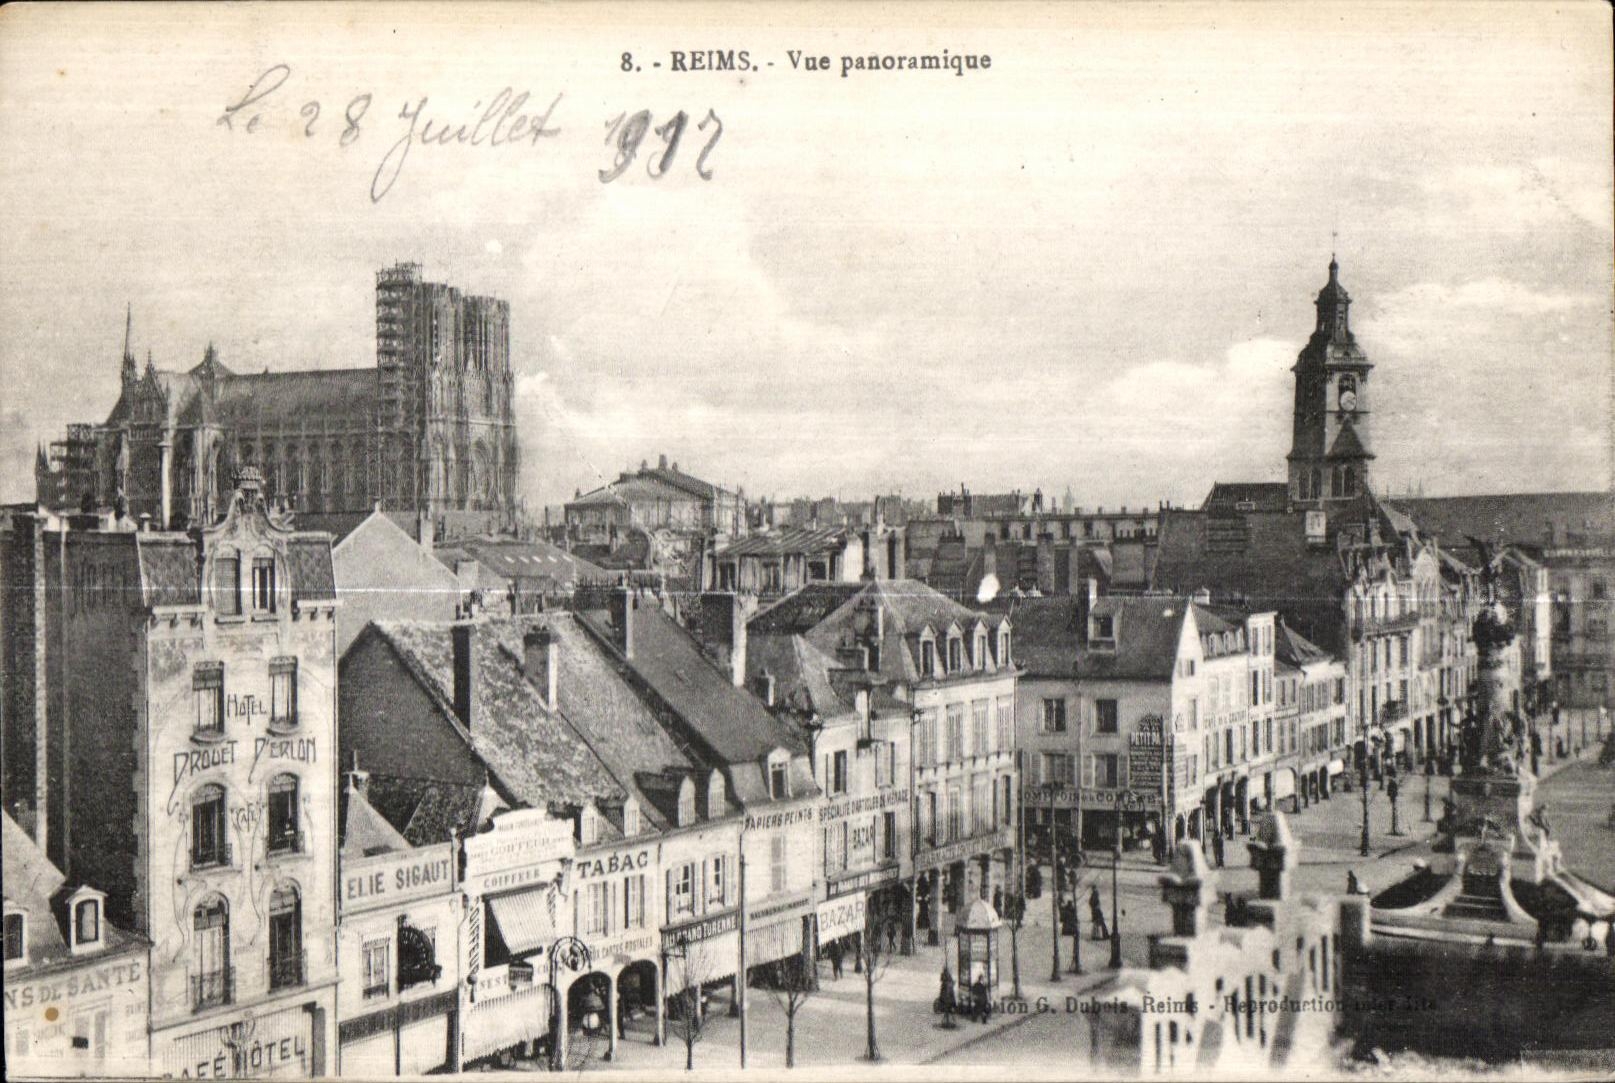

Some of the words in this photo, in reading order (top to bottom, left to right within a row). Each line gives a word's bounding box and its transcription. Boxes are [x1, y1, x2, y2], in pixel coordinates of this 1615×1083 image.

[302, 94, 371, 147] 28
[167, 740, 238, 816] DROUET
[248, 736, 316, 785] D'ERLON
[745, 811, 783, 830] PAPIERS
[784, 807, 812, 826] PEINTS
[394, 859, 449, 890] SIGAUT
[577, 851, 648, 880] TABAC
[702, 915, 737, 939] TURENNE
[819, 901, 865, 932] BAZAR
[67, 958, 141, 998] SANTÉ
[163, 1050, 226, 1079] AFÉ
